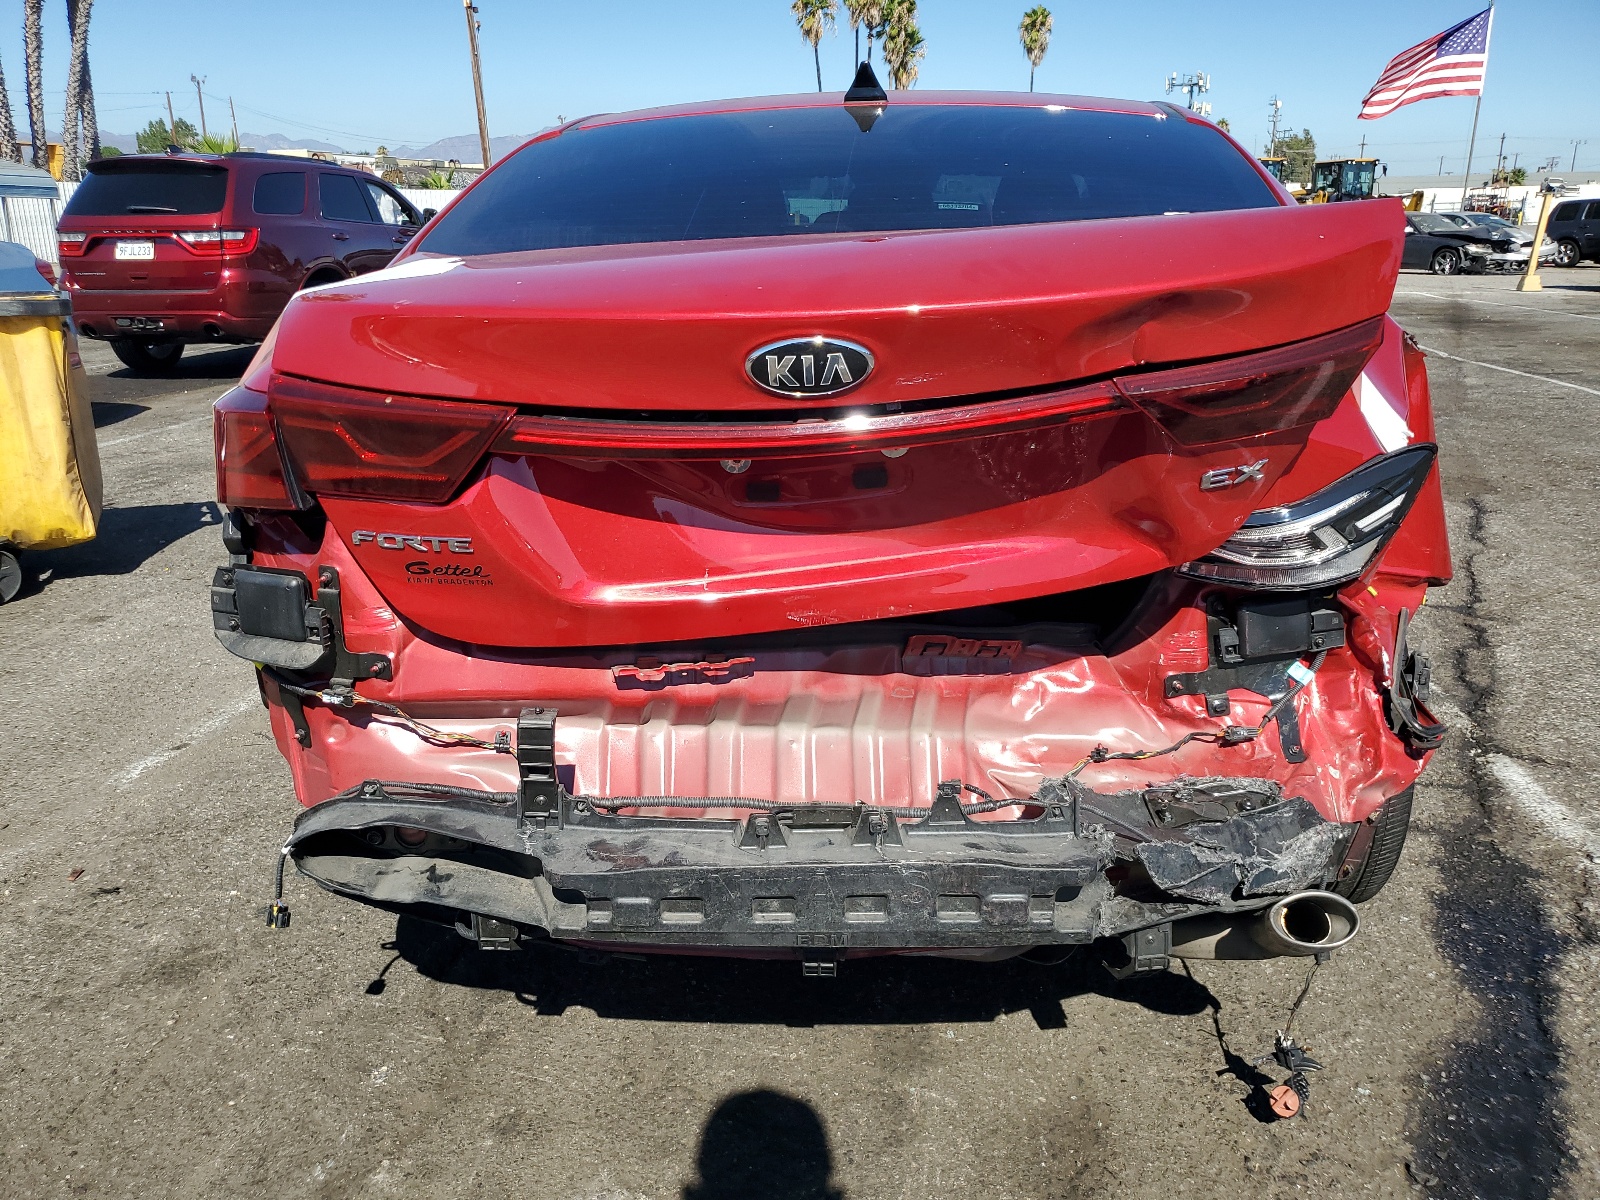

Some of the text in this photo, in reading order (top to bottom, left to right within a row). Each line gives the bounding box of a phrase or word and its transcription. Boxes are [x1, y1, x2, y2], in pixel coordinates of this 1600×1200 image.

[765, 352, 853, 387] KIA
[1200, 458, 1269, 490] EX
[351, 529, 474, 554] FORTE
[405, 561, 491, 578] Gettel
[406, 576, 422, 584] KIA
[437, 578, 494, 586] BRADENTON
